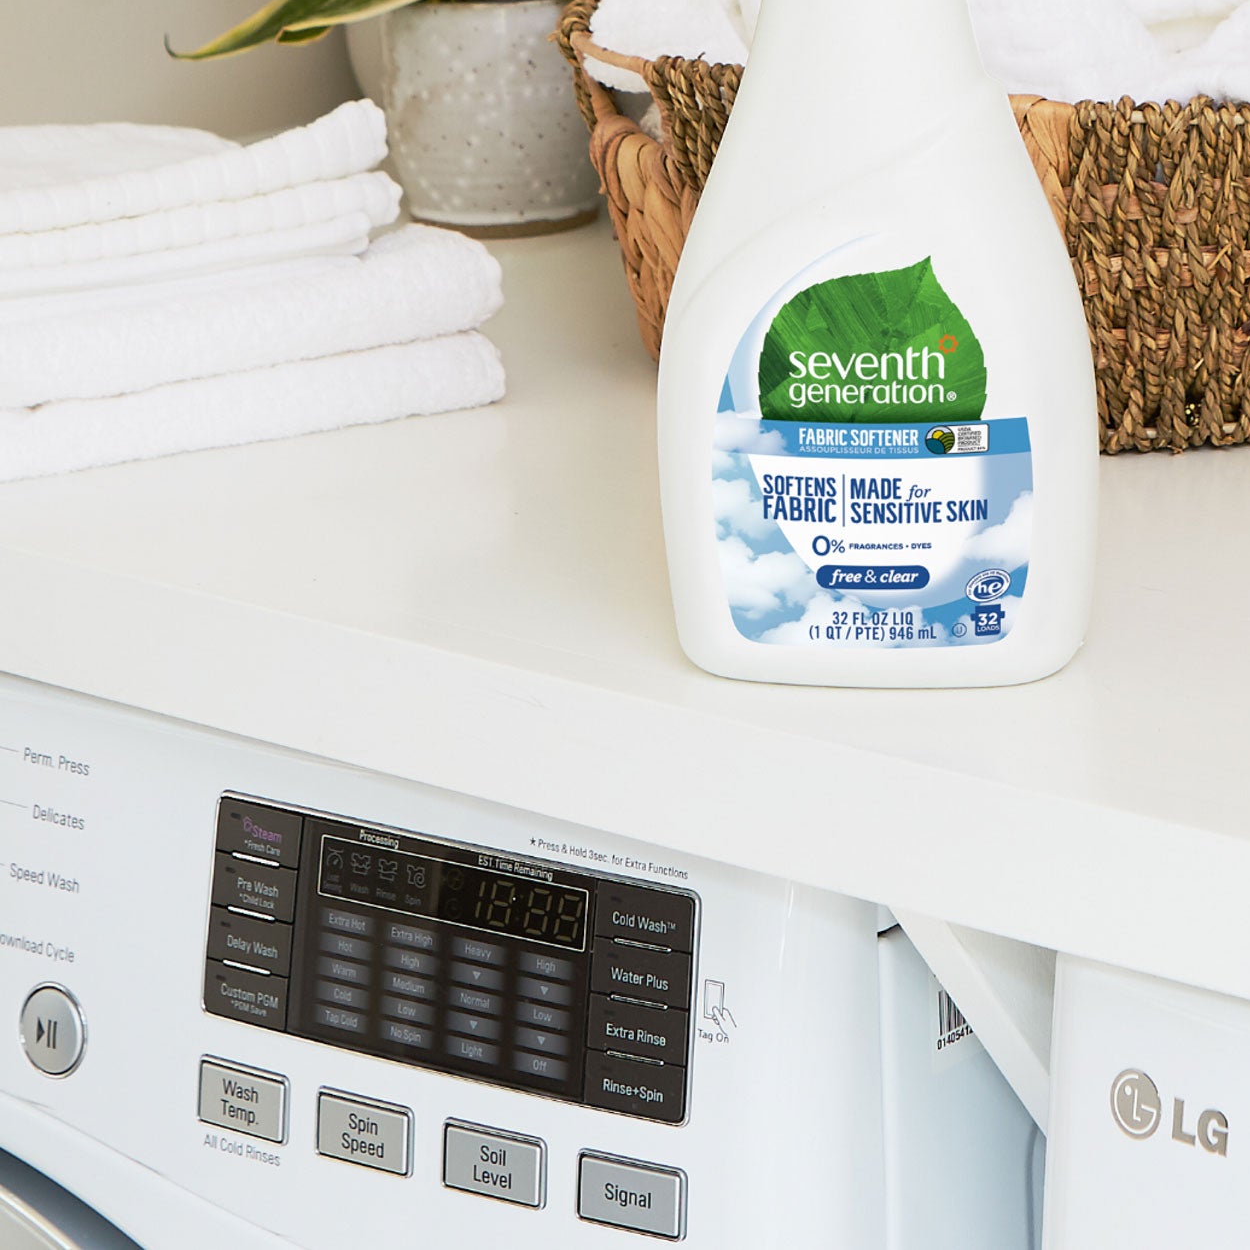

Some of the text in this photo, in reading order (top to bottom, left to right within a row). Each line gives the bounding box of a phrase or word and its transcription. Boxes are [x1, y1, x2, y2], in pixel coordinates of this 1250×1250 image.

[789, 346, 945, 380] seventh
[799, 428, 919, 447] FABRIC SOFTENER
[800, 446, 873, 455] ASSOUPLISSEUR
[874, 447, 887, 455] DE
[763, 474, 837, 497] SOFTENS
[850, 478, 931, 502] MADE for
[763, 495, 837, 523] FABRIC
[850, 499, 988, 524] SENSITIVE SKIN
[812, 535, 846, 556] 0%
[829, 569, 919, 586] free & clear
[977, 581, 1002, 595] he
[832, 611, 914, 626] 32 FL OZ LIQ
[976, 625, 1000, 633] LOADS
[977, 612, 998, 626] 32
[809, 625, 820, 640] (1
[826, 626, 842, 640] QT
[855, 626, 885, 641] PTE)
[889, 626, 914, 640] 946
[918, 626, 937, 640] mL
[23, 746, 90, 776] Perm. Press
[32, 804, 85, 830] Delicates
[251, 825, 282, 843] Steam
[360, 829, 399, 850] Processing
[538, 838, 689, 880] Press & Hold 3sec. for Extra Functions
[10, 862, 80, 894] Speed Wash
[513, 861, 553, 882] Remaining
[237, 876, 279, 898] Pre Wash
[328, 913, 366, 931] Extra Hot
[612, 911, 635, 928] Cold
[227, 934, 278, 959] Delay Wash
[338, 939, 353, 953] Hot
[391, 927, 433, 947] Extra High
[0, 933, 75, 964] ownload Cycle
[465, 943, 492, 960] Heavy
[331, 962, 357, 979] Warm
[401, 954, 420, 969] High
[536, 958, 556, 973] High
[392, 976, 425, 995] Medium
[611, 966, 669, 991] Water Plus
[221, 982, 279, 1009] Custom PGM
[333, 987, 352, 1002] Cold
[460, 992, 490, 1009] Normal
[325, 1010, 358, 1028] Tap Cold
[397, 1003, 416, 1017] Low
[533, 1008, 552, 1022] Low
[390, 1026, 422, 1044] No Spin
[606, 1023, 667, 1047] Extra Rinse
[697, 1028, 730, 1044] Tag On
[461, 1042, 483, 1057] Light
[532, 1059, 547, 1072] Off
[222, 1078, 259, 1104] Wash
[602, 1078, 664, 1103] Rinse+Spin
[220, 1099, 260, 1126] Temp.
[349, 1113, 379, 1136] Spin
[1171, 1097, 1228, 1158] LG
[203, 1134, 281, 1168] All Cold Rinses
[341, 1132, 385, 1159] Speed
[480, 1145, 507, 1167] Soil
[473, 1164, 512, 1190] Level
[604, 1182, 652, 1210] Signal
